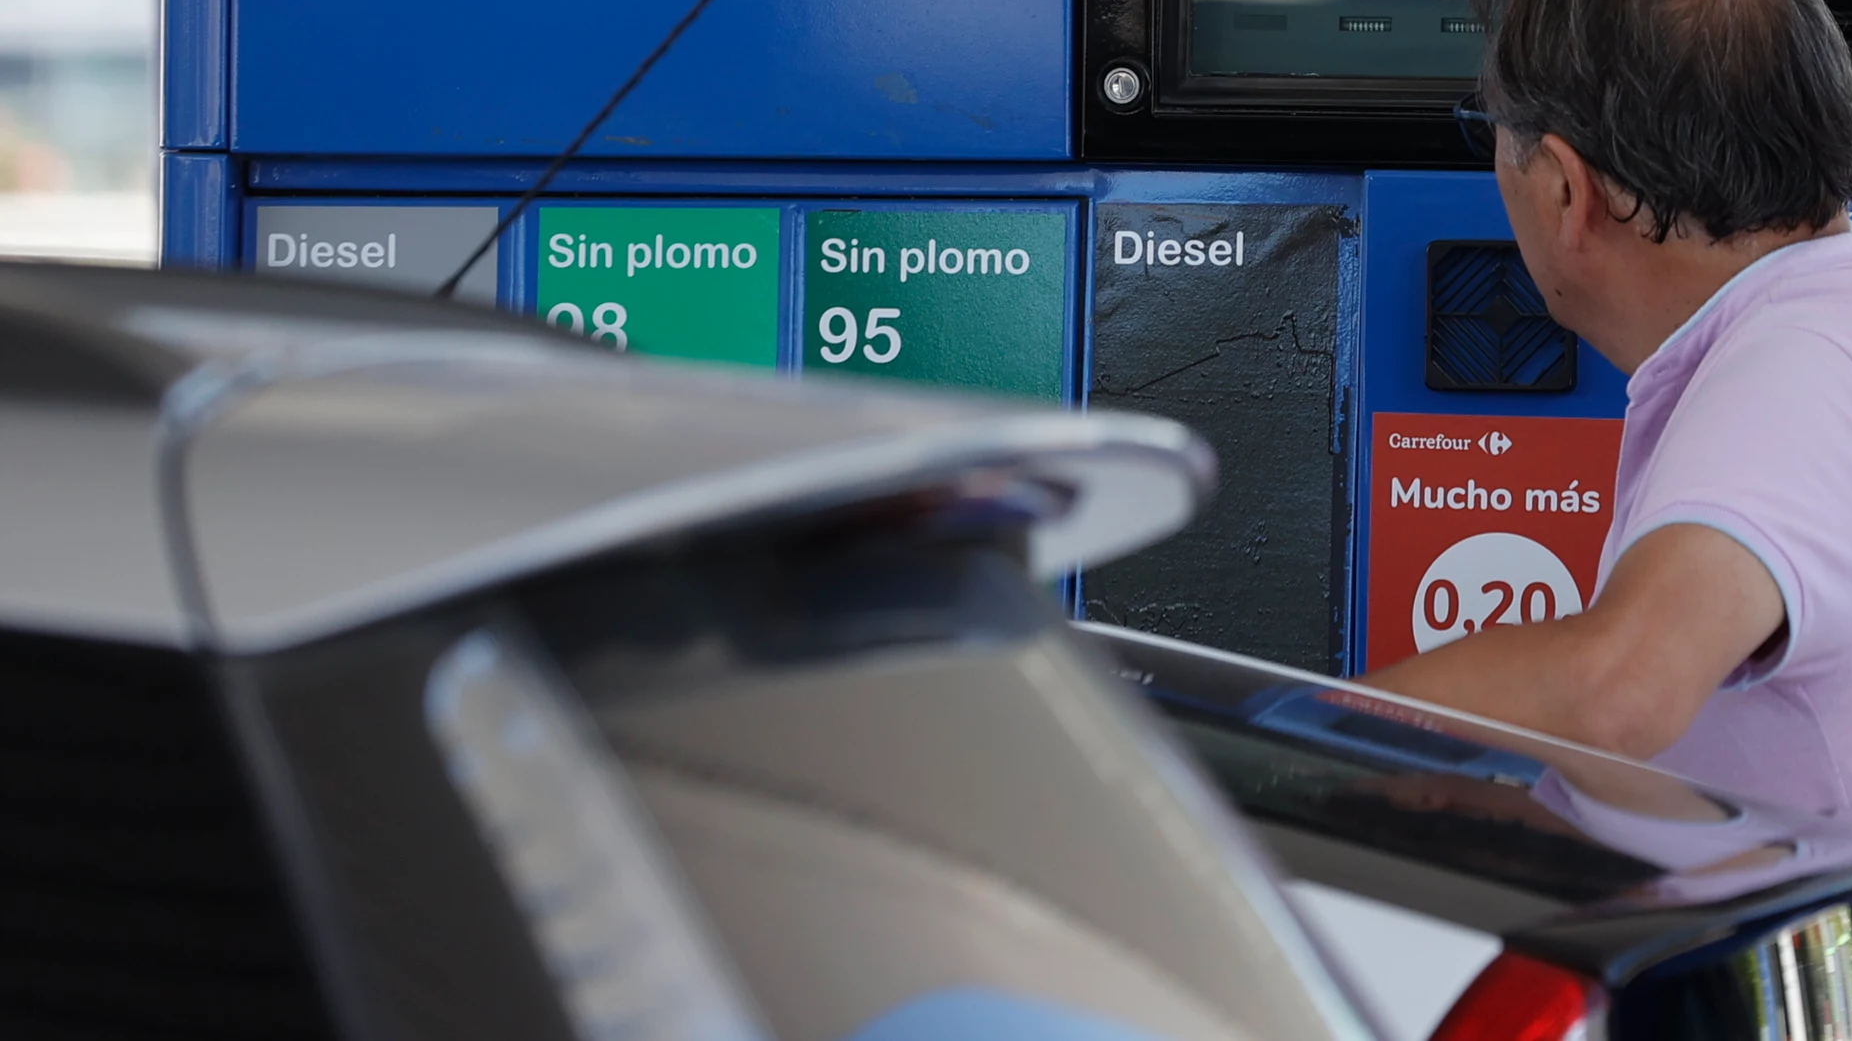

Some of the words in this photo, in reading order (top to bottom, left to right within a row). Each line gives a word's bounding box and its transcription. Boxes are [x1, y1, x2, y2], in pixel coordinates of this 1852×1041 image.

[267, 233, 396, 268] Diesel
[548, 233, 613, 268] Sin
[627, 234, 757, 277] plomo
[820, 237, 886, 274] Sin
[900, 238, 1030, 283] plomo
[1114, 230, 1244, 267] Diesel
[818, 306, 902, 364] 95
[1389, 432, 1471, 451] Carrefour
[1390, 477, 1512, 511] Mucho
[1525, 480, 1600, 513] más
